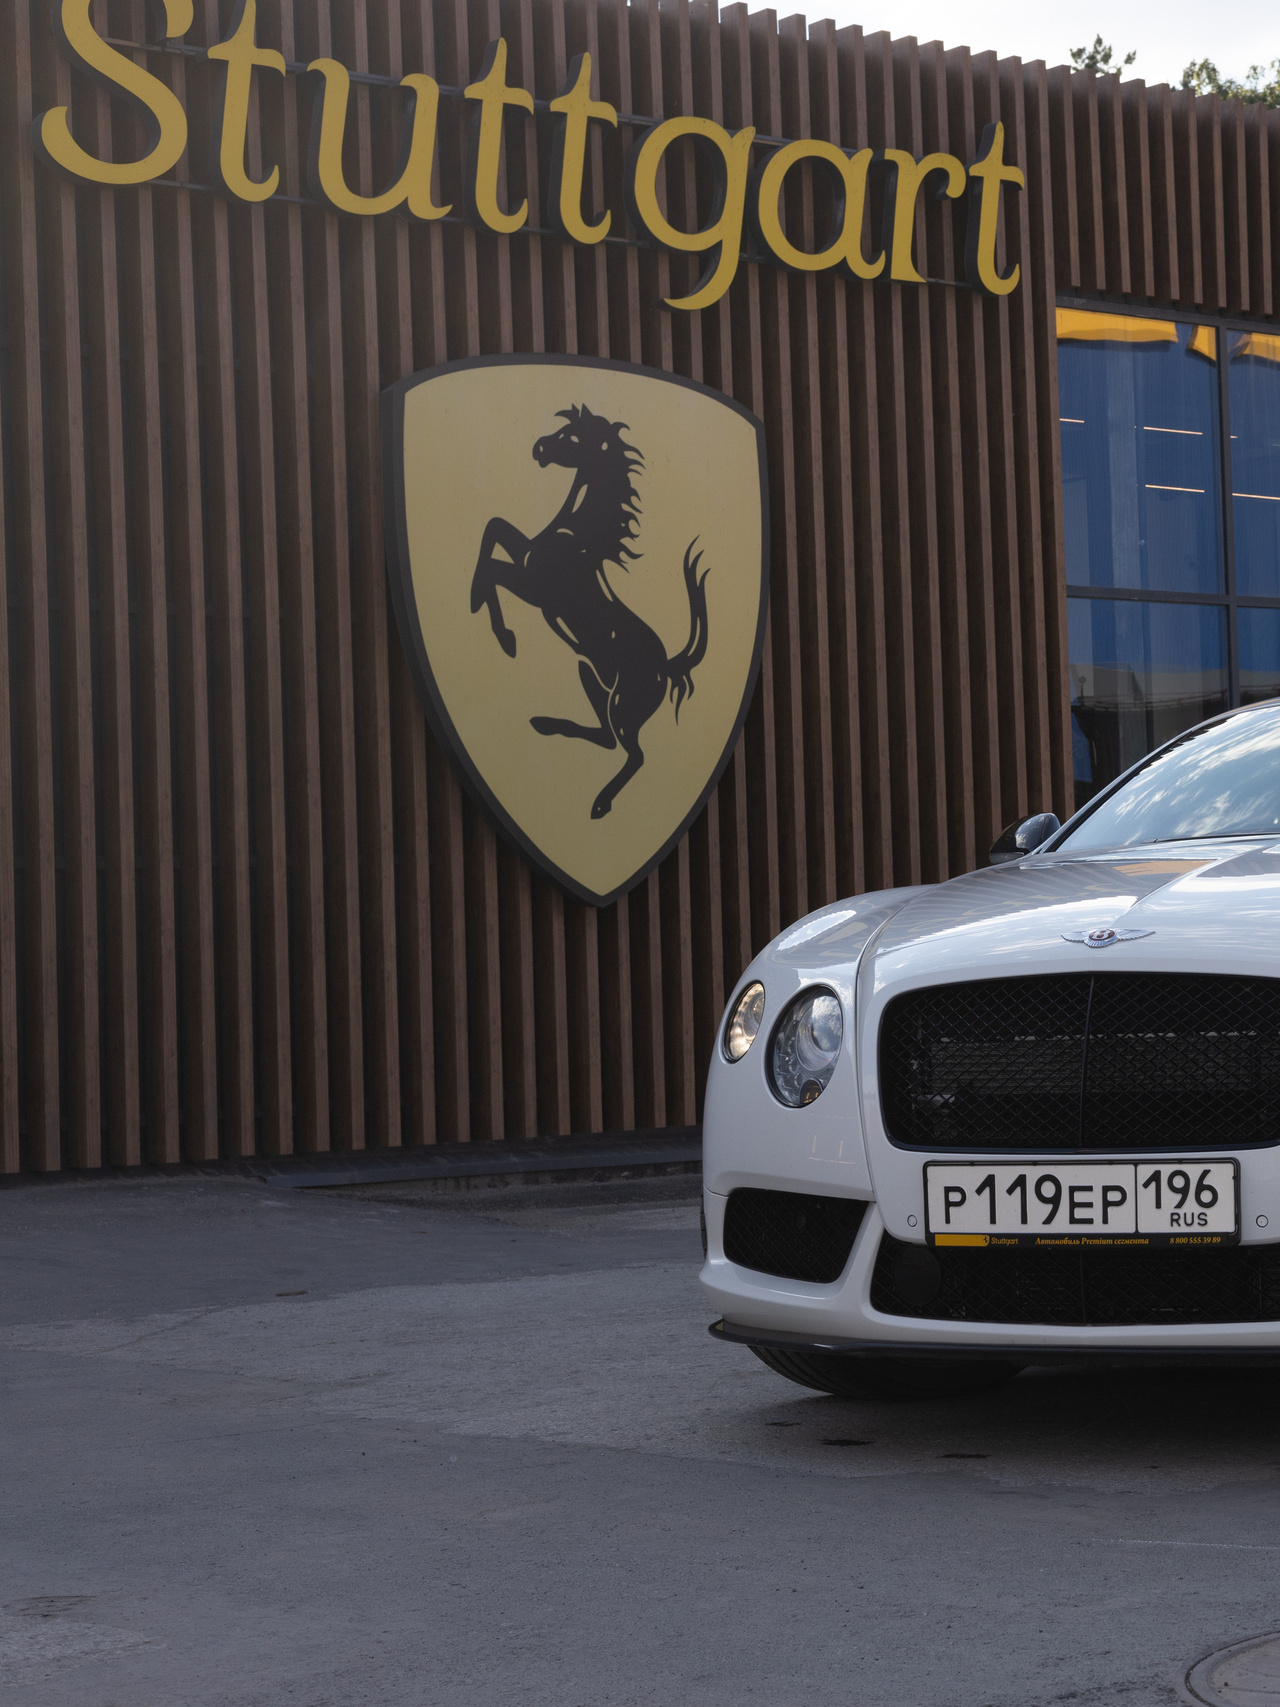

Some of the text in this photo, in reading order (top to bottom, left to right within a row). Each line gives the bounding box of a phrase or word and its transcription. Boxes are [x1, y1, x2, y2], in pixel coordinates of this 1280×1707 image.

[40, 0, 1025, 310] Stuttgart
[943, 1169, 1219, 1226] Р119ЕР 196
[1170, 1212, 1209, 1227] RUS
[990, 1237, 1019, 1246] Stuttgart
[1035, 1236, 1081, 1245] Автомобиль
[1081, 1237, 1113, 1245] Premium
